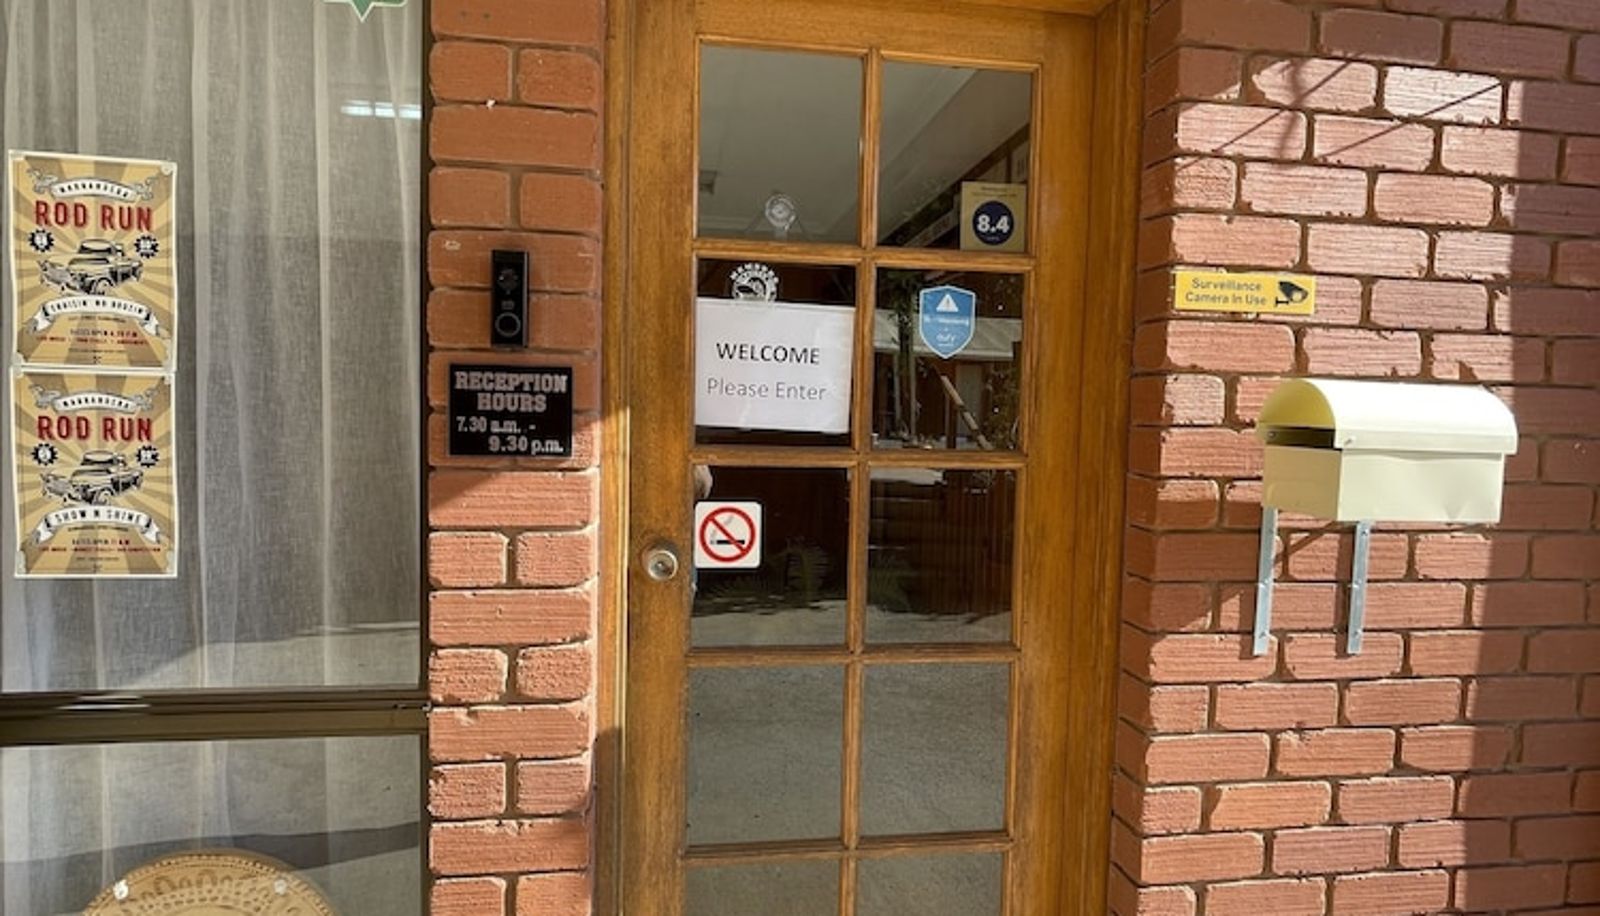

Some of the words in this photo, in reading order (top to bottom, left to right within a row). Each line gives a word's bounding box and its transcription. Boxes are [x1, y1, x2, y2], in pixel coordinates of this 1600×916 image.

[35, 200, 87, 228] ROD
[101, 204, 151, 232] RUN
[977, 214, 1010, 233] 8.4
[1192, 277, 1262, 291] Surveillance
[1185, 292, 1230, 304] Camera
[1232, 294, 1242, 304] In
[1246, 295, 1266, 305] Use
[716, 342, 820, 365] WELCOME
[454, 370, 568, 394] RECEPTION
[707, 377, 769, 398] Please
[775, 381, 827, 401] Enter
[477, 392, 547, 412] HOURS
[37, 415, 90, 440] ROD
[103, 417, 152, 442] RUN
[456, 415, 488, 433] 7.30
[488, 435, 528, 452] 9.30
[530, 439, 564, 456] p.m.
